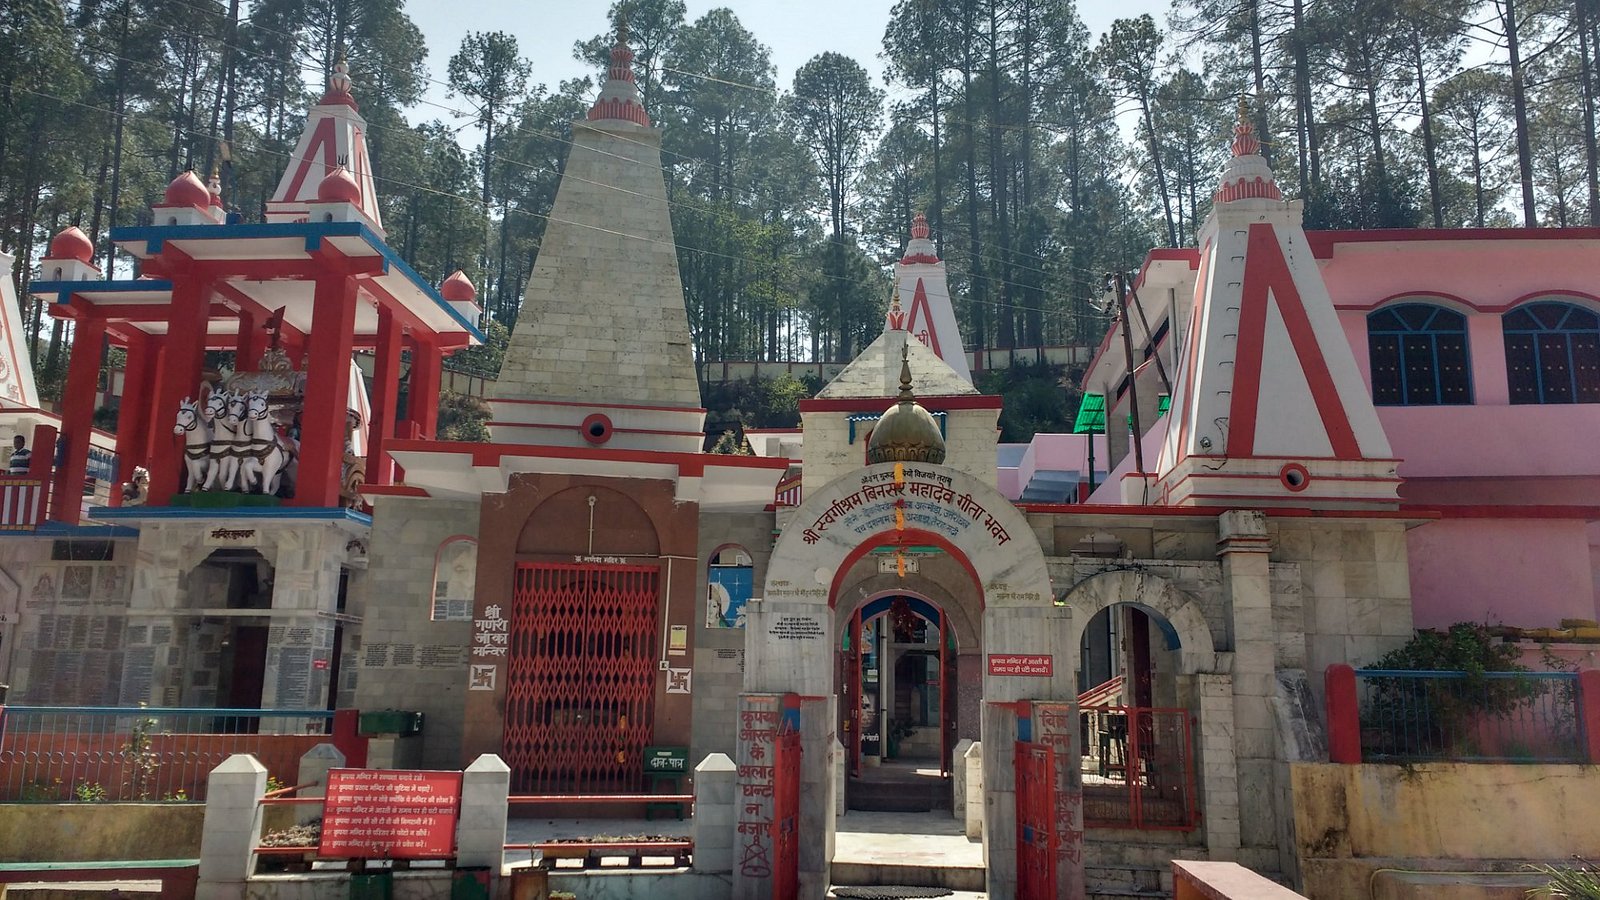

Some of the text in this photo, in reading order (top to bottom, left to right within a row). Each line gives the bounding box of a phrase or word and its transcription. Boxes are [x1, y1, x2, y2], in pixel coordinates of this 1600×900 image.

[803, 528, 821, 546] श्री
[812, 491, 863, 531] स्वर्गाश्रम
[862, 482, 905, 503] बिनसर
[909, 482, 957, 504] महादेव
[957, 493, 986, 521] गीता
[984, 513, 1012, 547] भवन
[485, 604, 501, 619] श्री
[474, 618, 508, 631] गणेश
[475, 630, 509, 644] जी का
[473, 644, 508, 656] मन्दिर
[750, 742, 765, 761] के
[745, 802, 762, 816] न
